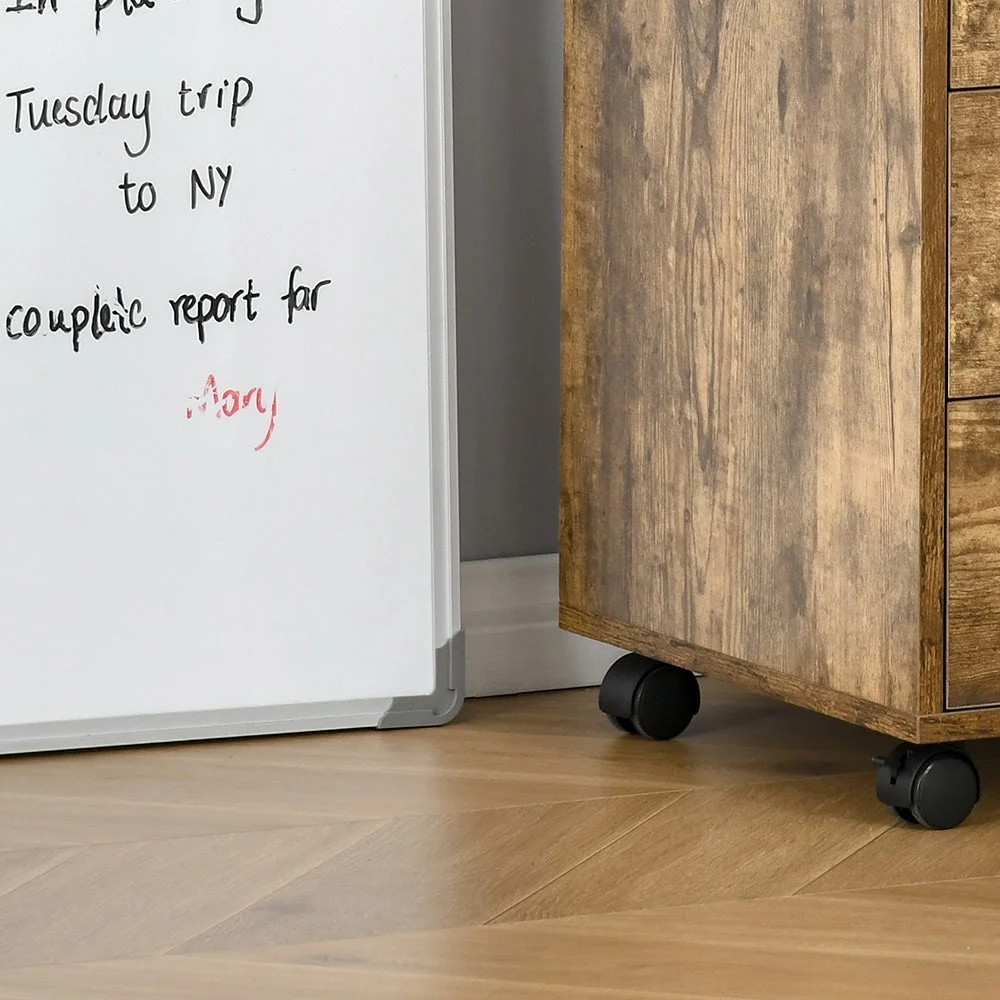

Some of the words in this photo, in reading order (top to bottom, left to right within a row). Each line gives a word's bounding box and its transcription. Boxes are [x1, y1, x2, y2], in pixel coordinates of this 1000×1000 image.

[6, 82, 151, 158] Tuesday
[178, 77, 254, 128] trip
[118, 172, 157, 214] to
[191, 164, 233, 210] NY
[169, 279, 260, 344] report
[281, 265, 332, 324] for
